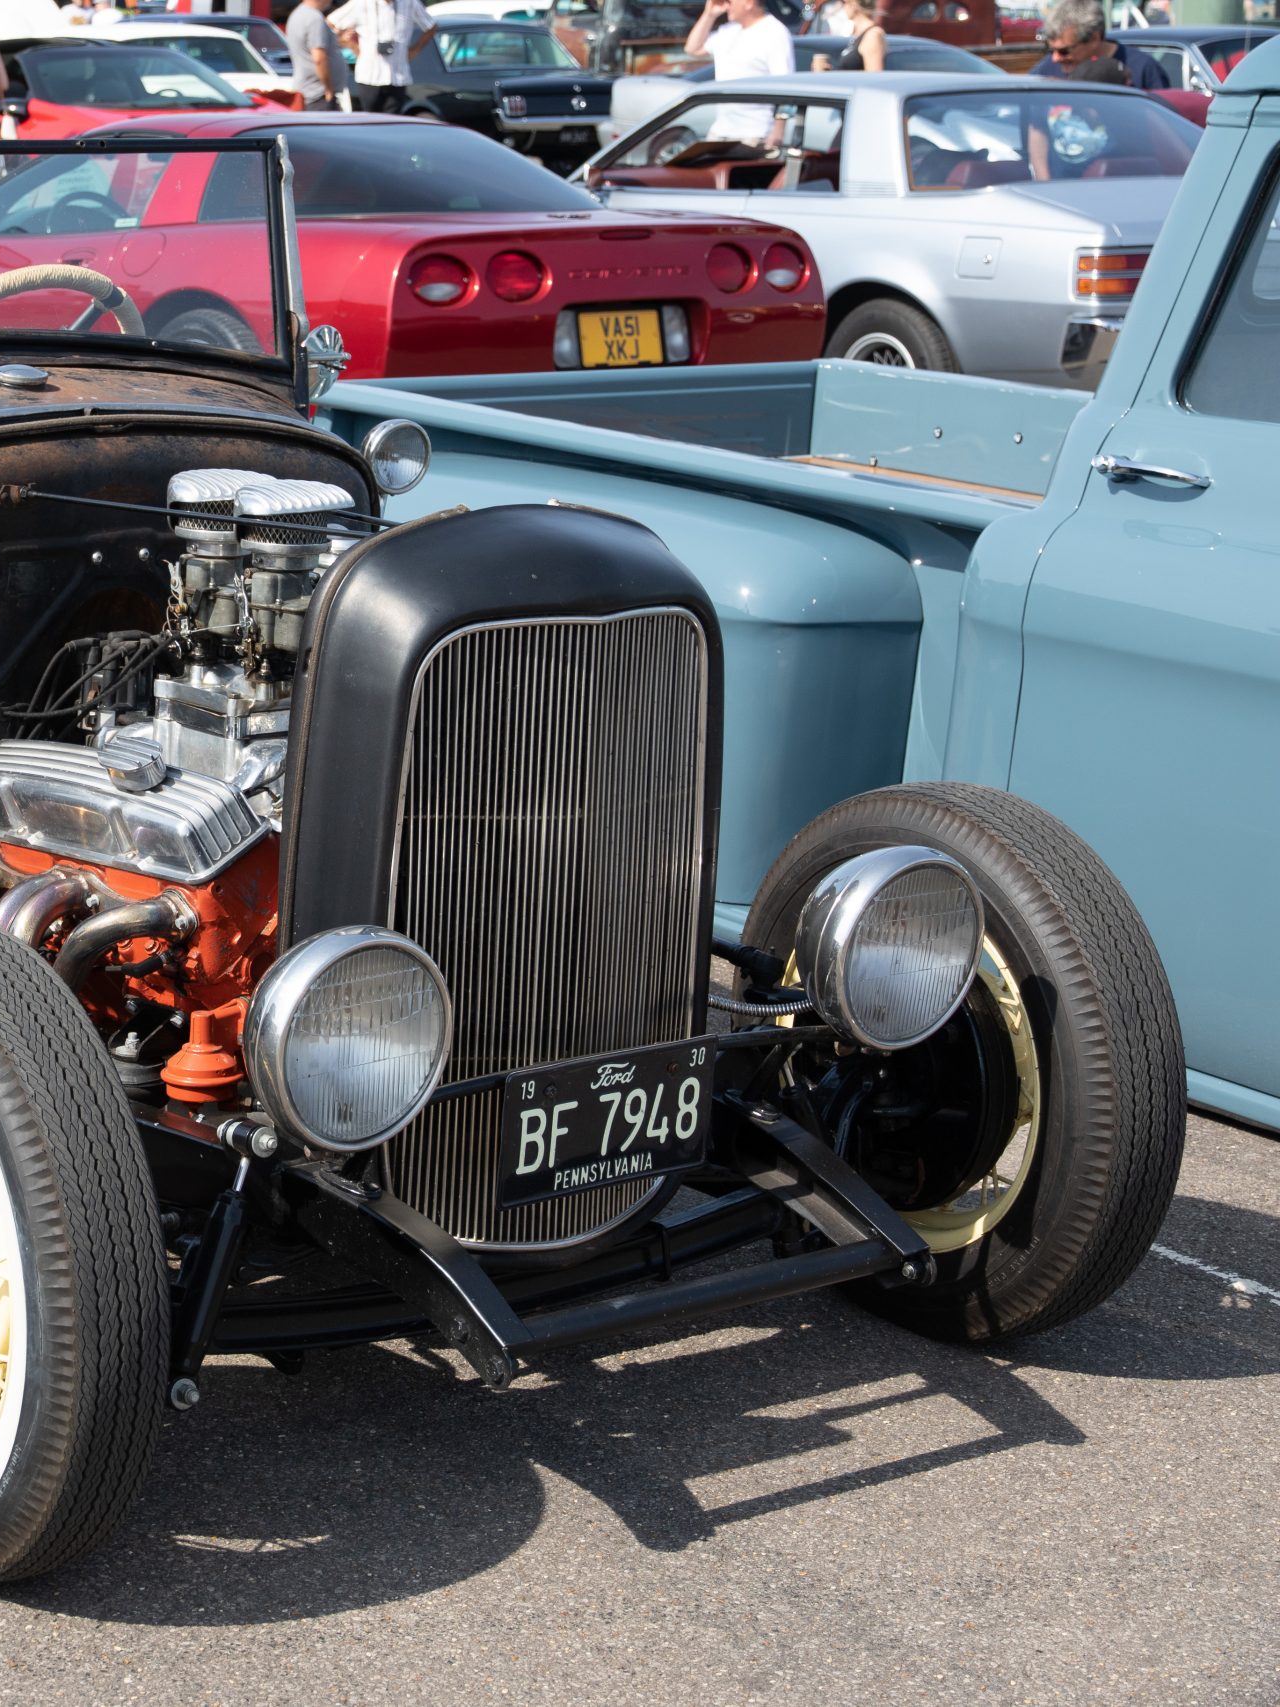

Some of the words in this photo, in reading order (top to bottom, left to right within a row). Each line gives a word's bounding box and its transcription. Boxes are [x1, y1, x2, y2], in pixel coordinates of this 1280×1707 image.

[600, 317, 640, 337] VA51
[605, 339, 640, 361] XKJ
[521, 1080, 536, 1100] 19
[590, 1062, 637, 1090] Ford
[689, 1046, 706, 1067] 30
[515, 1100, 579, 1176] BF
[599, 1076, 701, 1157] 7948
[553, 1152, 653, 1191] PENNSYLVANIA
